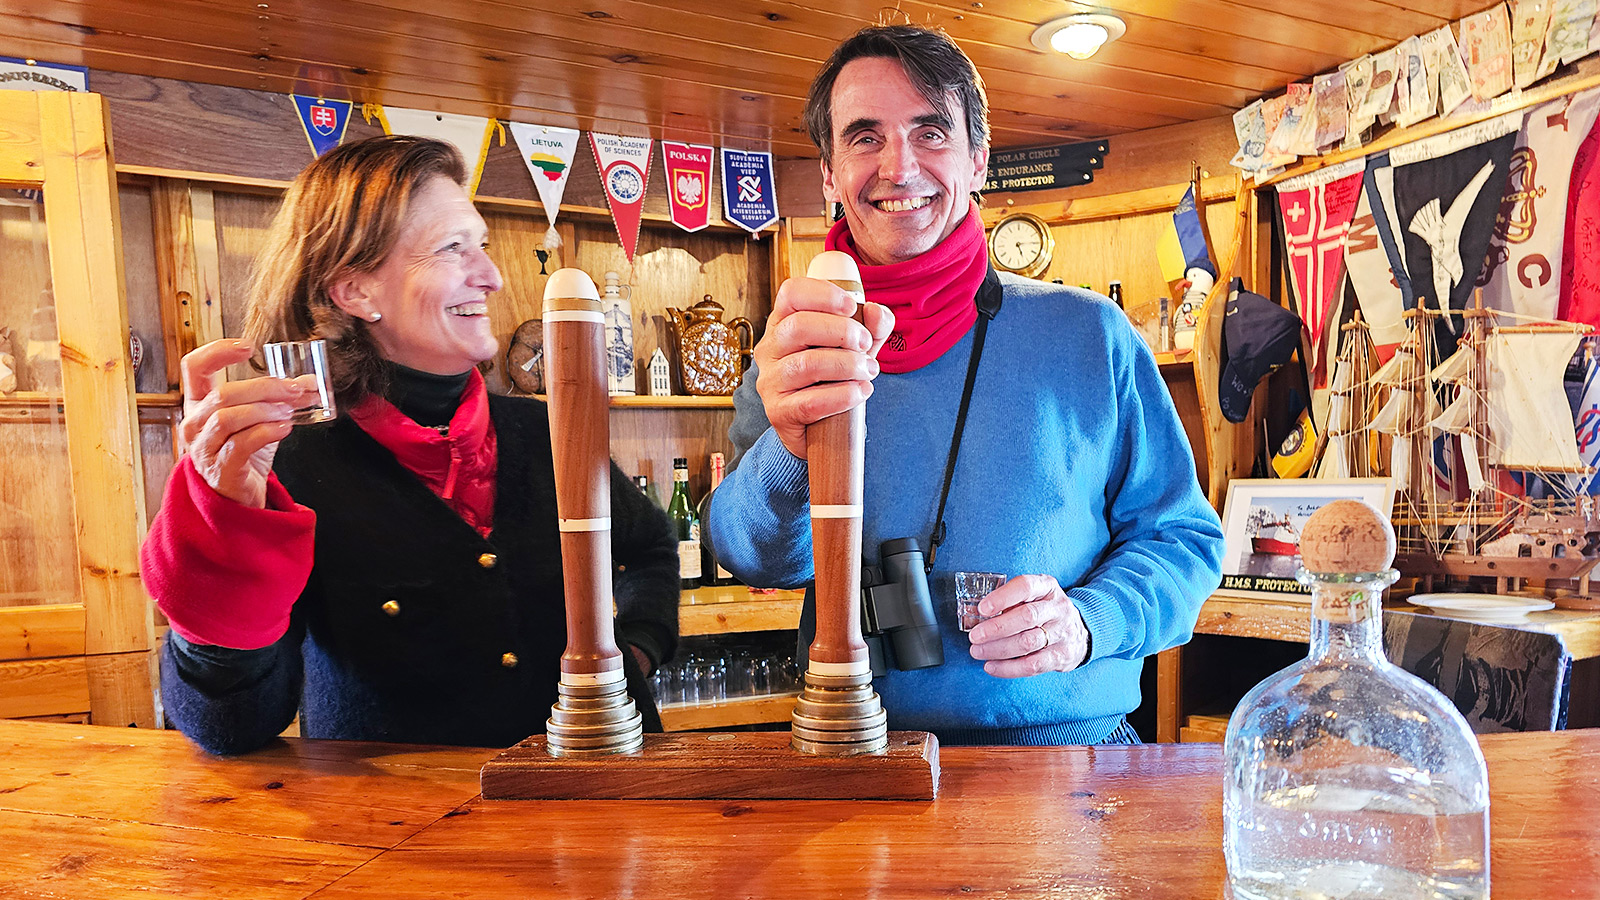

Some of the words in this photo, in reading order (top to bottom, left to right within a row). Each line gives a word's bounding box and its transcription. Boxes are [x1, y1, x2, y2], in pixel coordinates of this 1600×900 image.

[531, 138, 564, 149] LIETUVA
[597, 137, 619, 147] POLISH
[620, 140, 649, 150] ACADEMY
[613, 147, 642, 156] SCIENCES
[669, 150, 707, 163] POLSKA
[996, 153, 1026, 164] POLAR
[1028, 148, 1060, 159] CIRCLE
[998, 163, 1053, 177] ENDURANCE
[1002, 175, 1055, 189] PROTECTOR
[1254, 577, 1313, 594] PROTECTO
